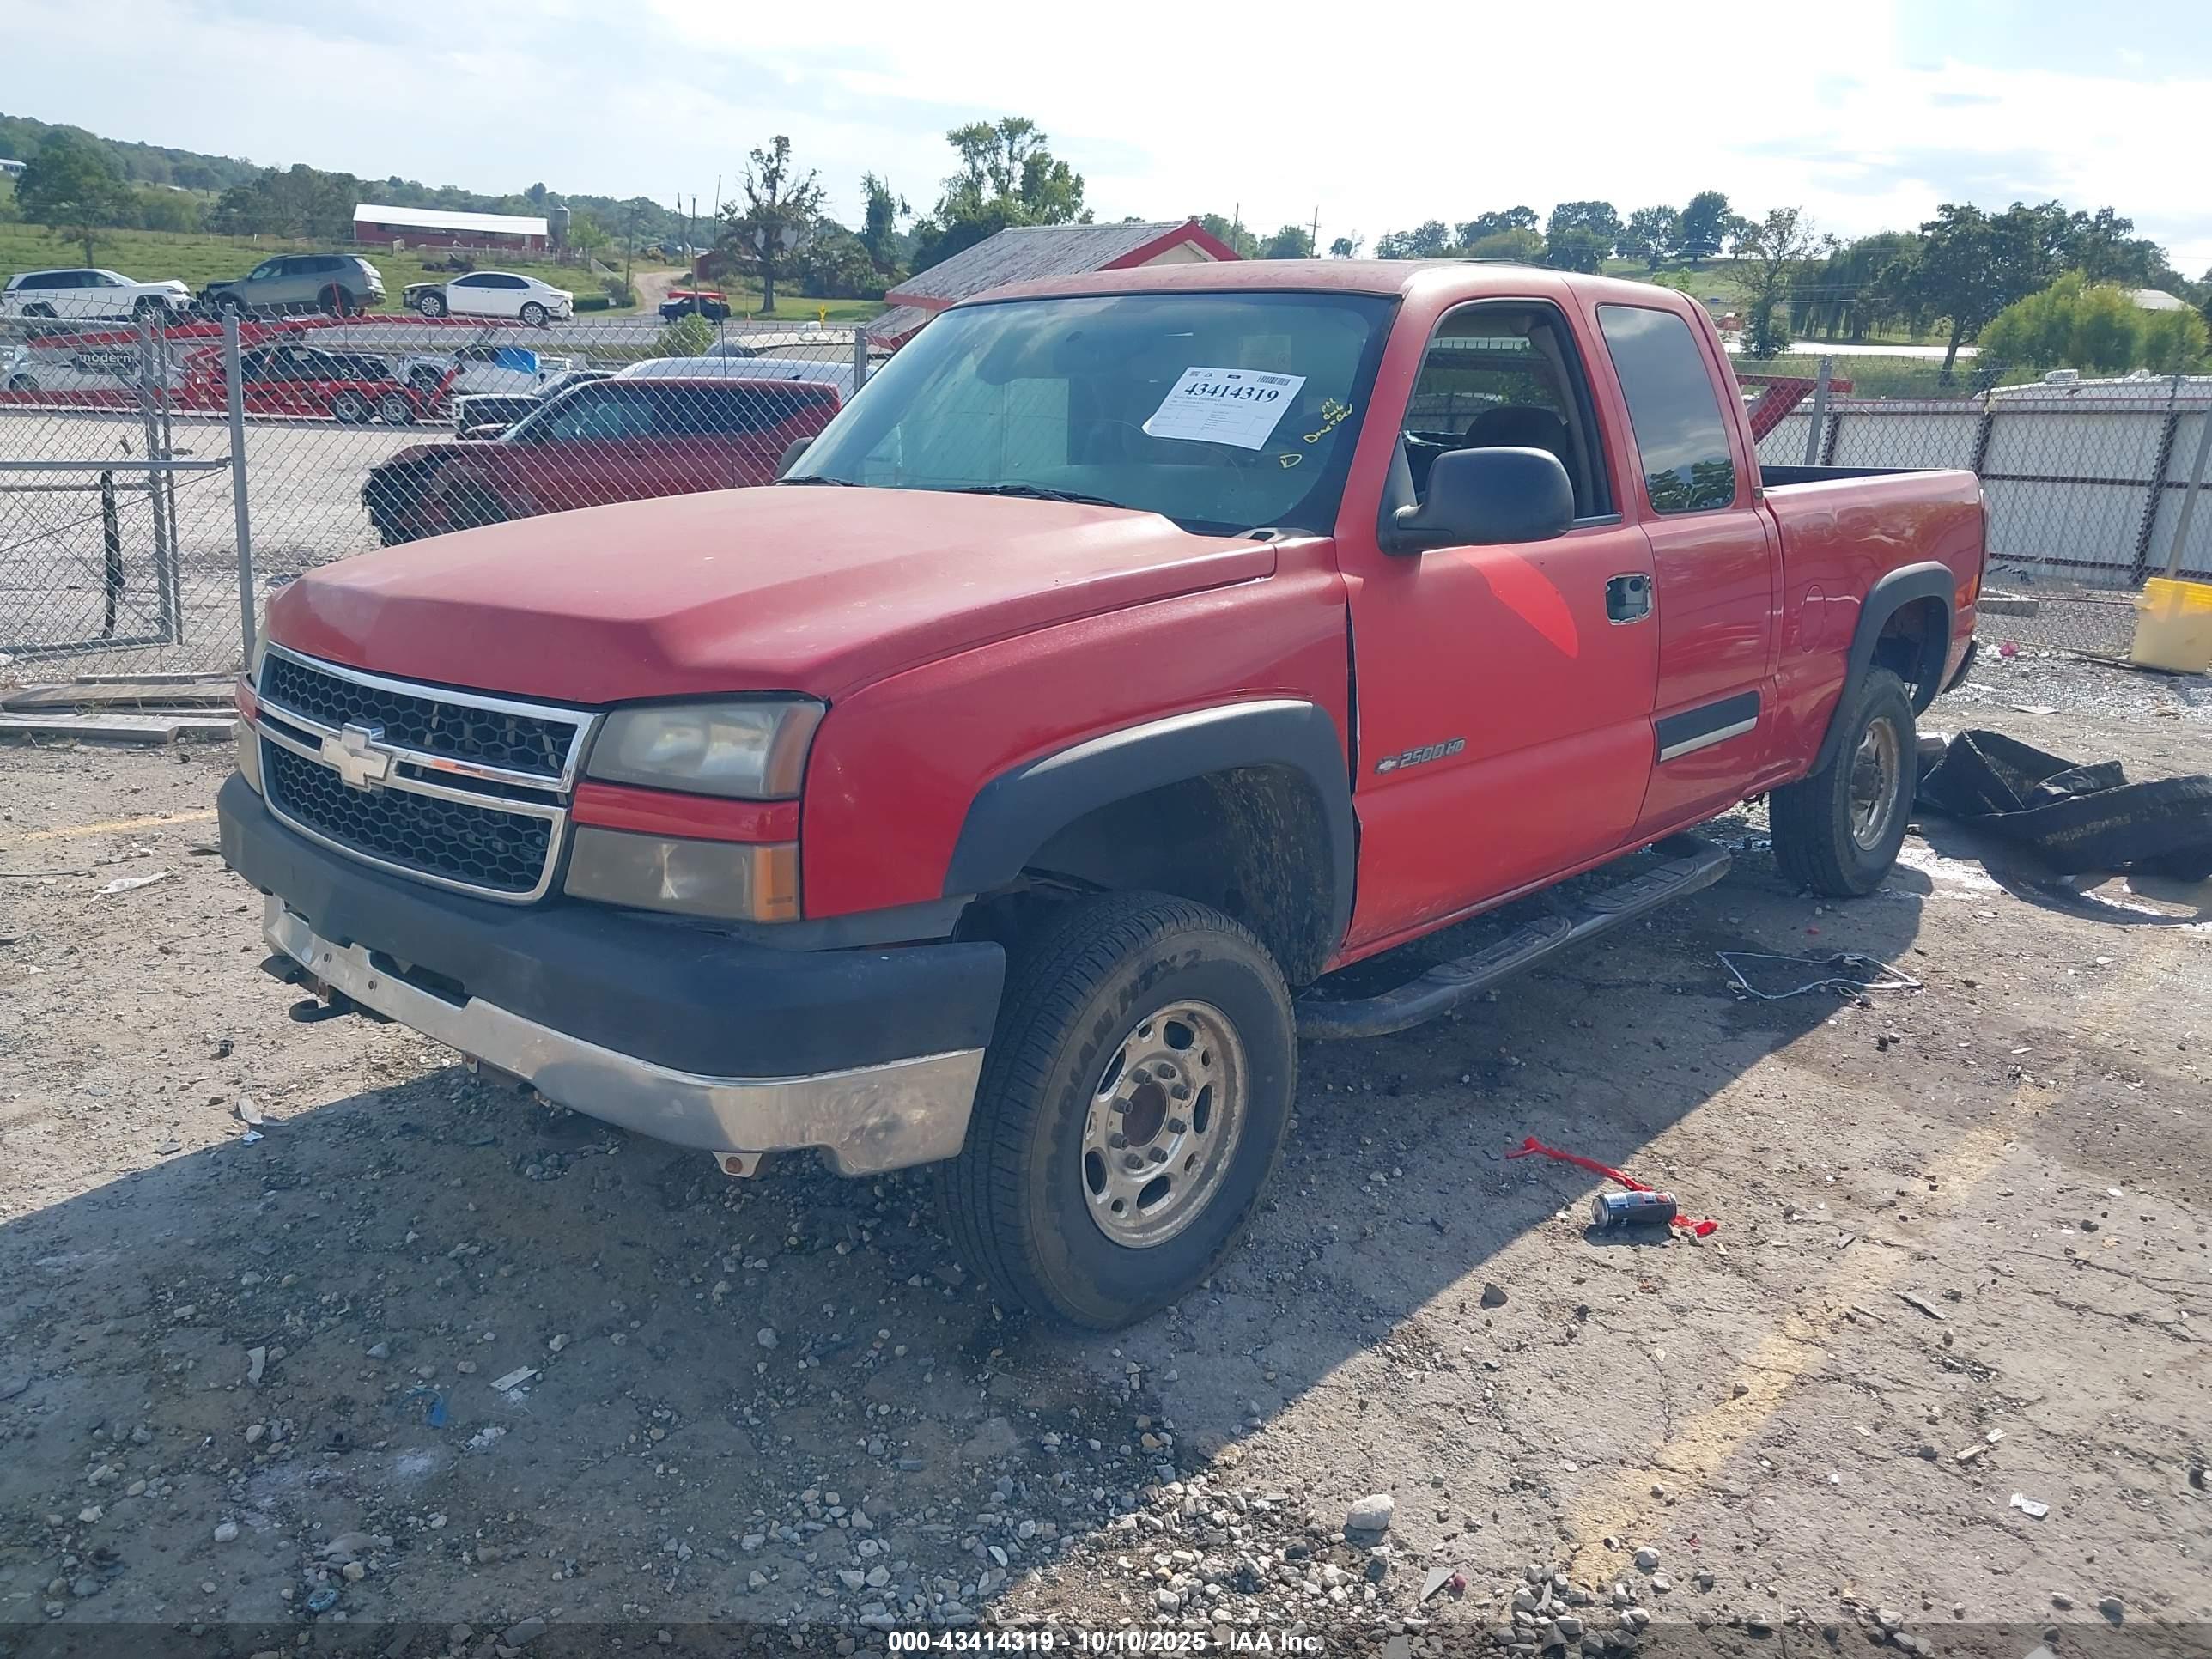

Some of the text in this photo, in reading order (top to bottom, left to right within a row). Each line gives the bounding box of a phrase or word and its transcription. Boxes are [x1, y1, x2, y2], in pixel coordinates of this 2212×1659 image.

[79, 353, 131, 363] modern
[1184, 382, 1279, 404] 43414319
[1400, 739, 1466, 769] 2500 HD
